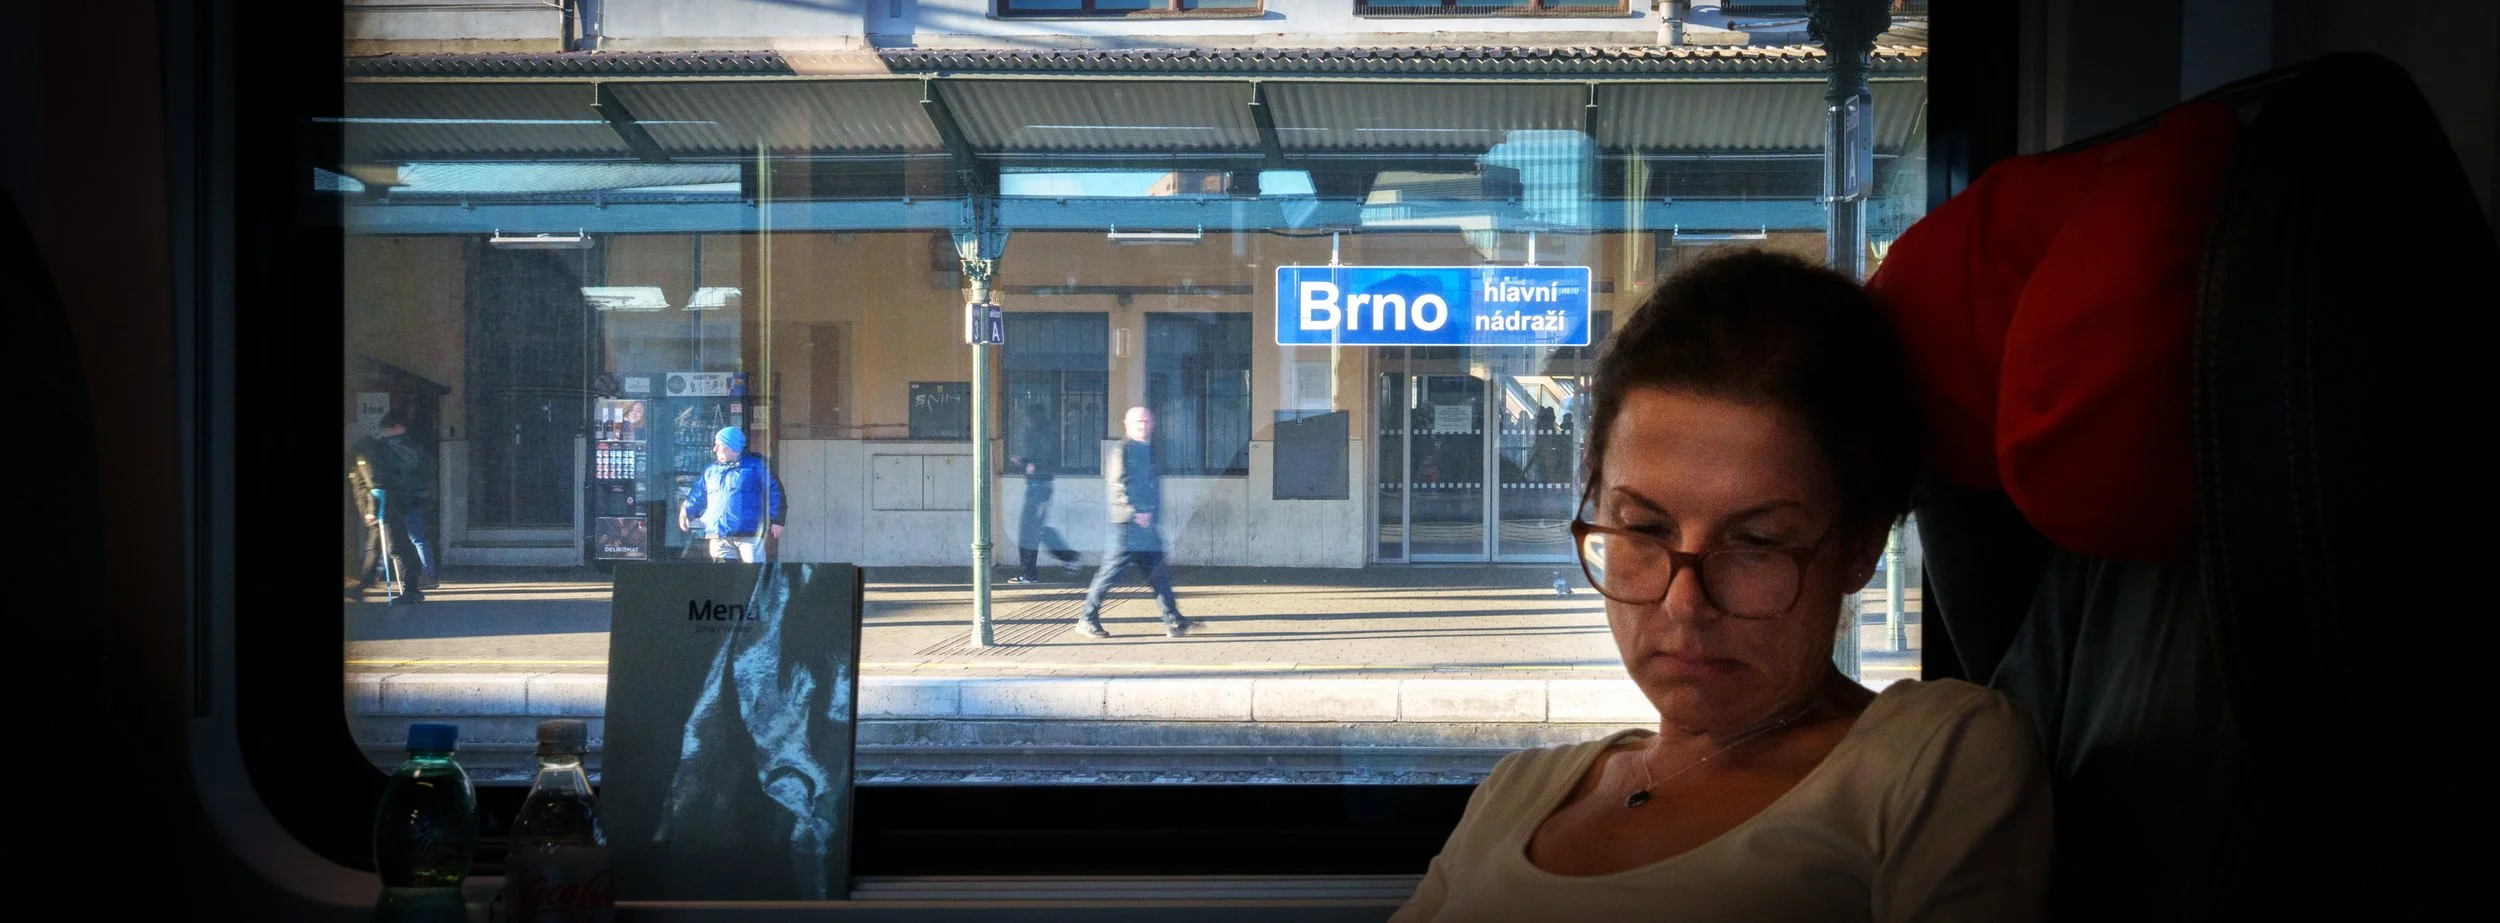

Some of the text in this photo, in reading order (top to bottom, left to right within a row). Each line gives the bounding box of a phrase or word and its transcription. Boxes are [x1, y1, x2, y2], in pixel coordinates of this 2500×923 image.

[1848, 140, 1856, 188] A
[1483, 280, 1558, 302] hlavní
[1300, 281, 1448, 332] Brno
[974, 320, 979, 341] 3
[992, 321, 1000, 341] A
[1475, 309, 1567, 331] nádraží
[688, 600, 760, 621] Menu
